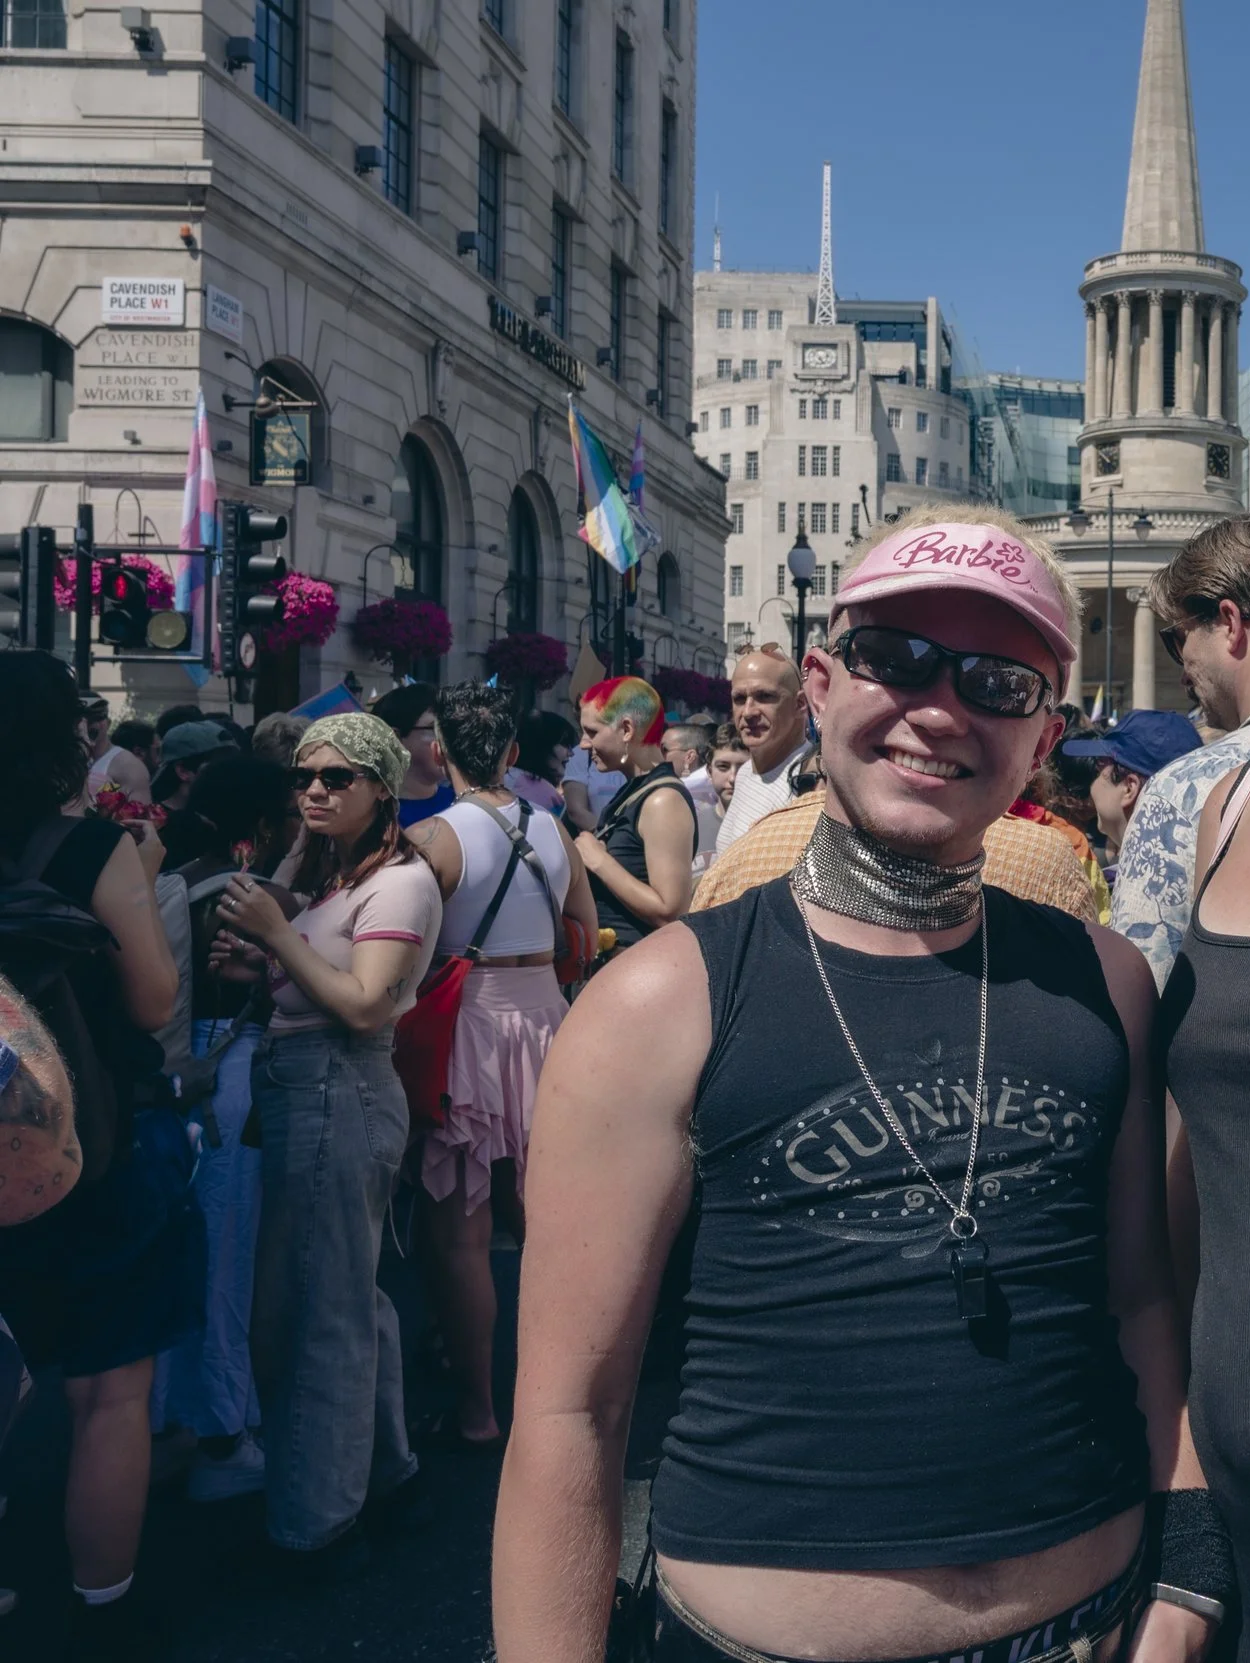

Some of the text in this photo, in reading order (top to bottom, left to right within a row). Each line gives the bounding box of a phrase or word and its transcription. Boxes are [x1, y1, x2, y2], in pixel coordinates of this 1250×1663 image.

[109, 282, 176, 296] CAVENDISH
[109, 296, 169, 309] PLACE W1
[95, 333, 195, 347] CAVENDISH
[101, 351, 157, 364] PLACE
[97, 375, 179, 386] LEADING TO
[83, 387, 165, 402] WIGMORE
[892, 531, 1031, 585] Barbie
[785, 1085, 1086, 1185] GUINNESS
